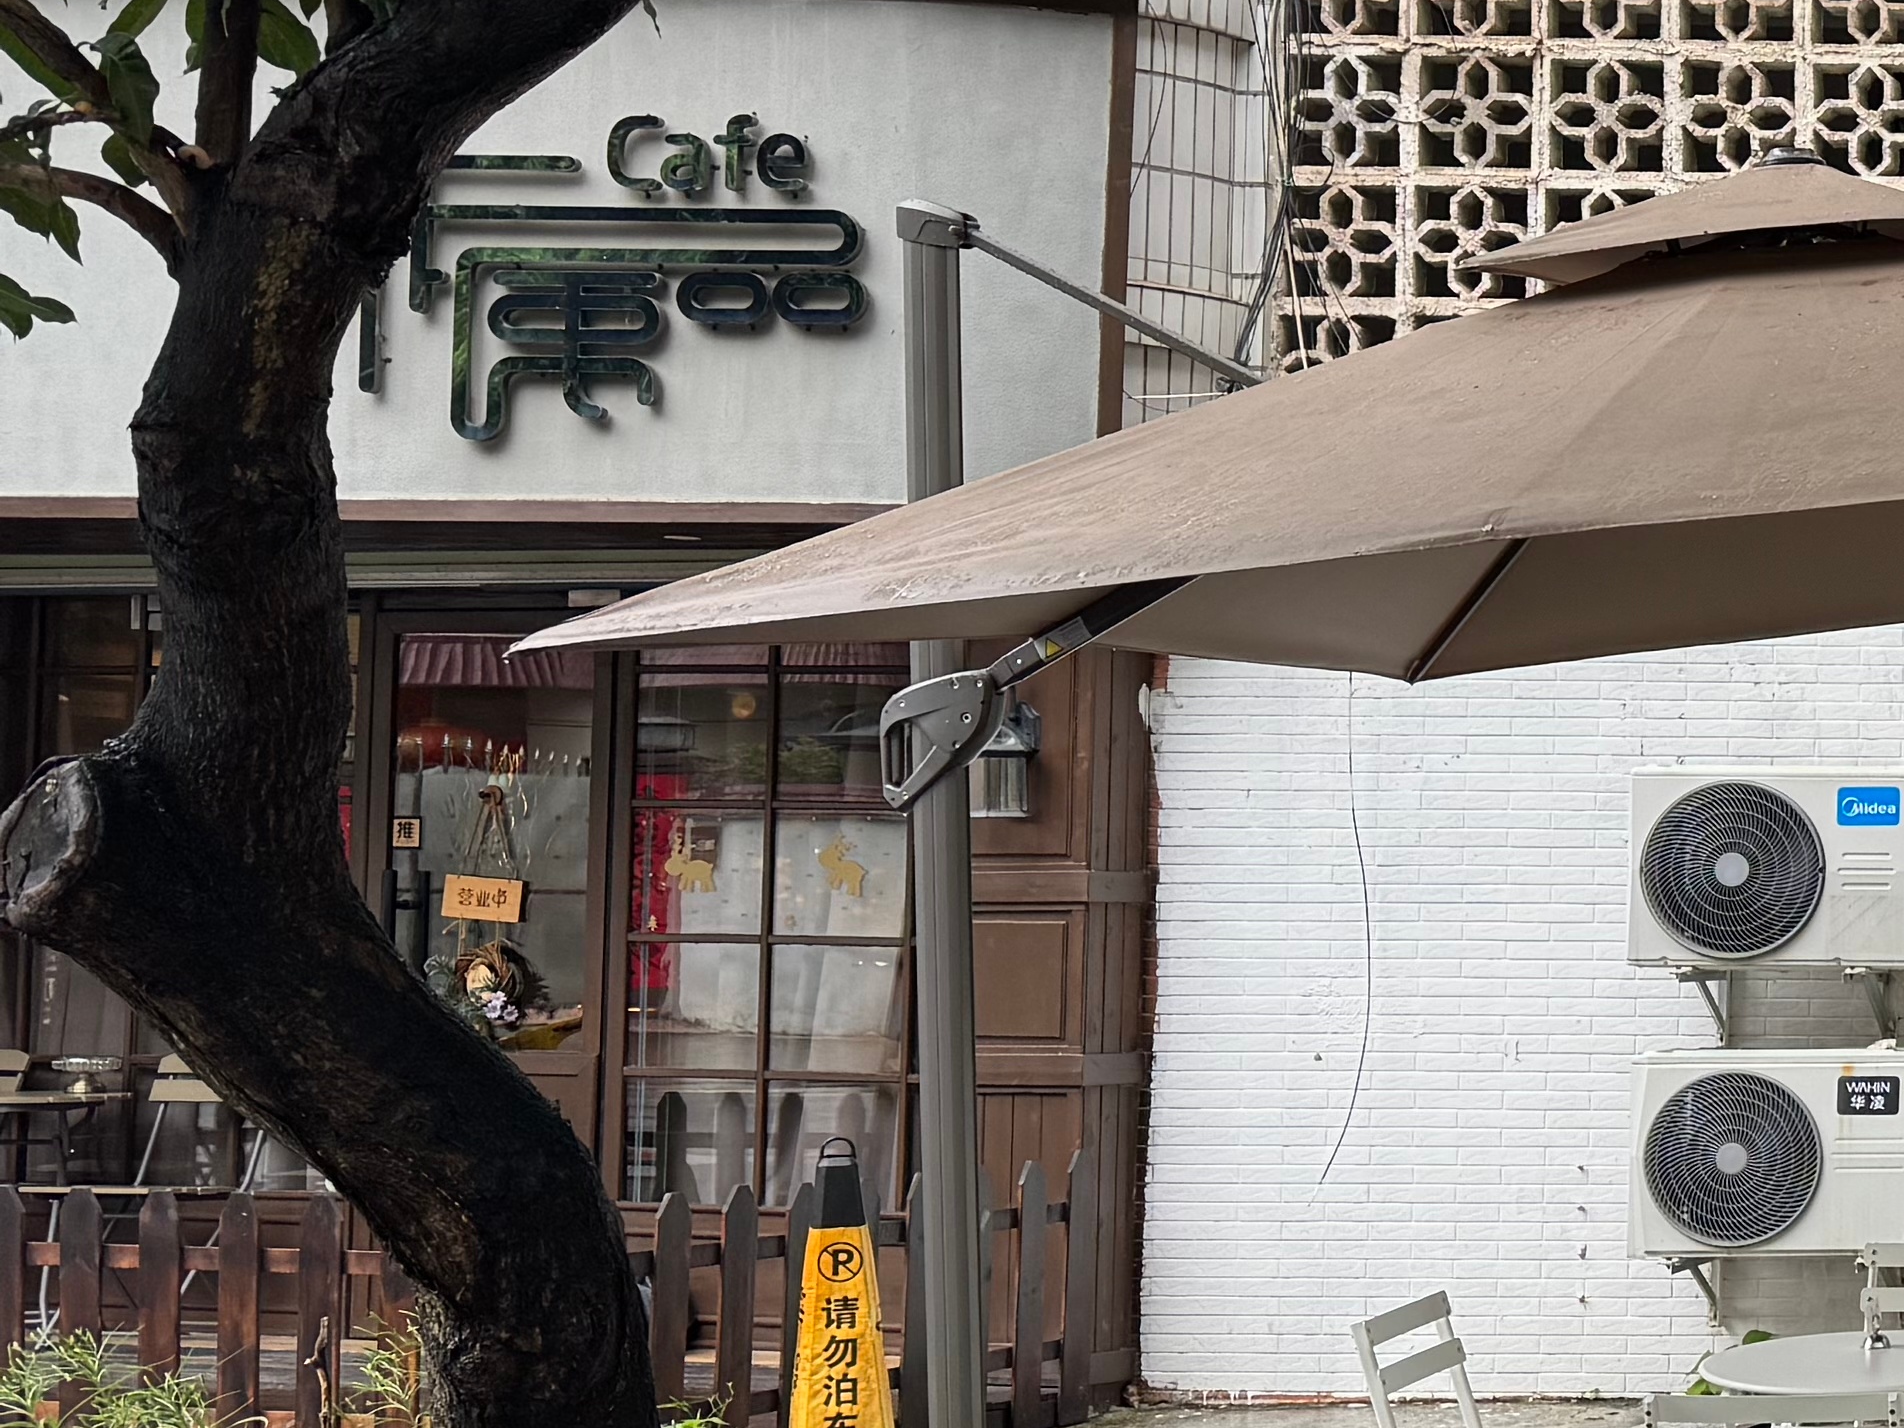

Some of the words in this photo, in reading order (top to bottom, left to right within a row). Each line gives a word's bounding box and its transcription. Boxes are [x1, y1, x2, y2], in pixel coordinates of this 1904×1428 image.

[607, 113, 811, 192] Cafe
[1841, 796, 1897, 817] Midea
[397, 821, 416, 840] 推
[457, 887, 508, 908] 营业中
[1845, 1081, 1891, 1094] WAHIN
[1849, 1094, 1886, 1111] 华凌
